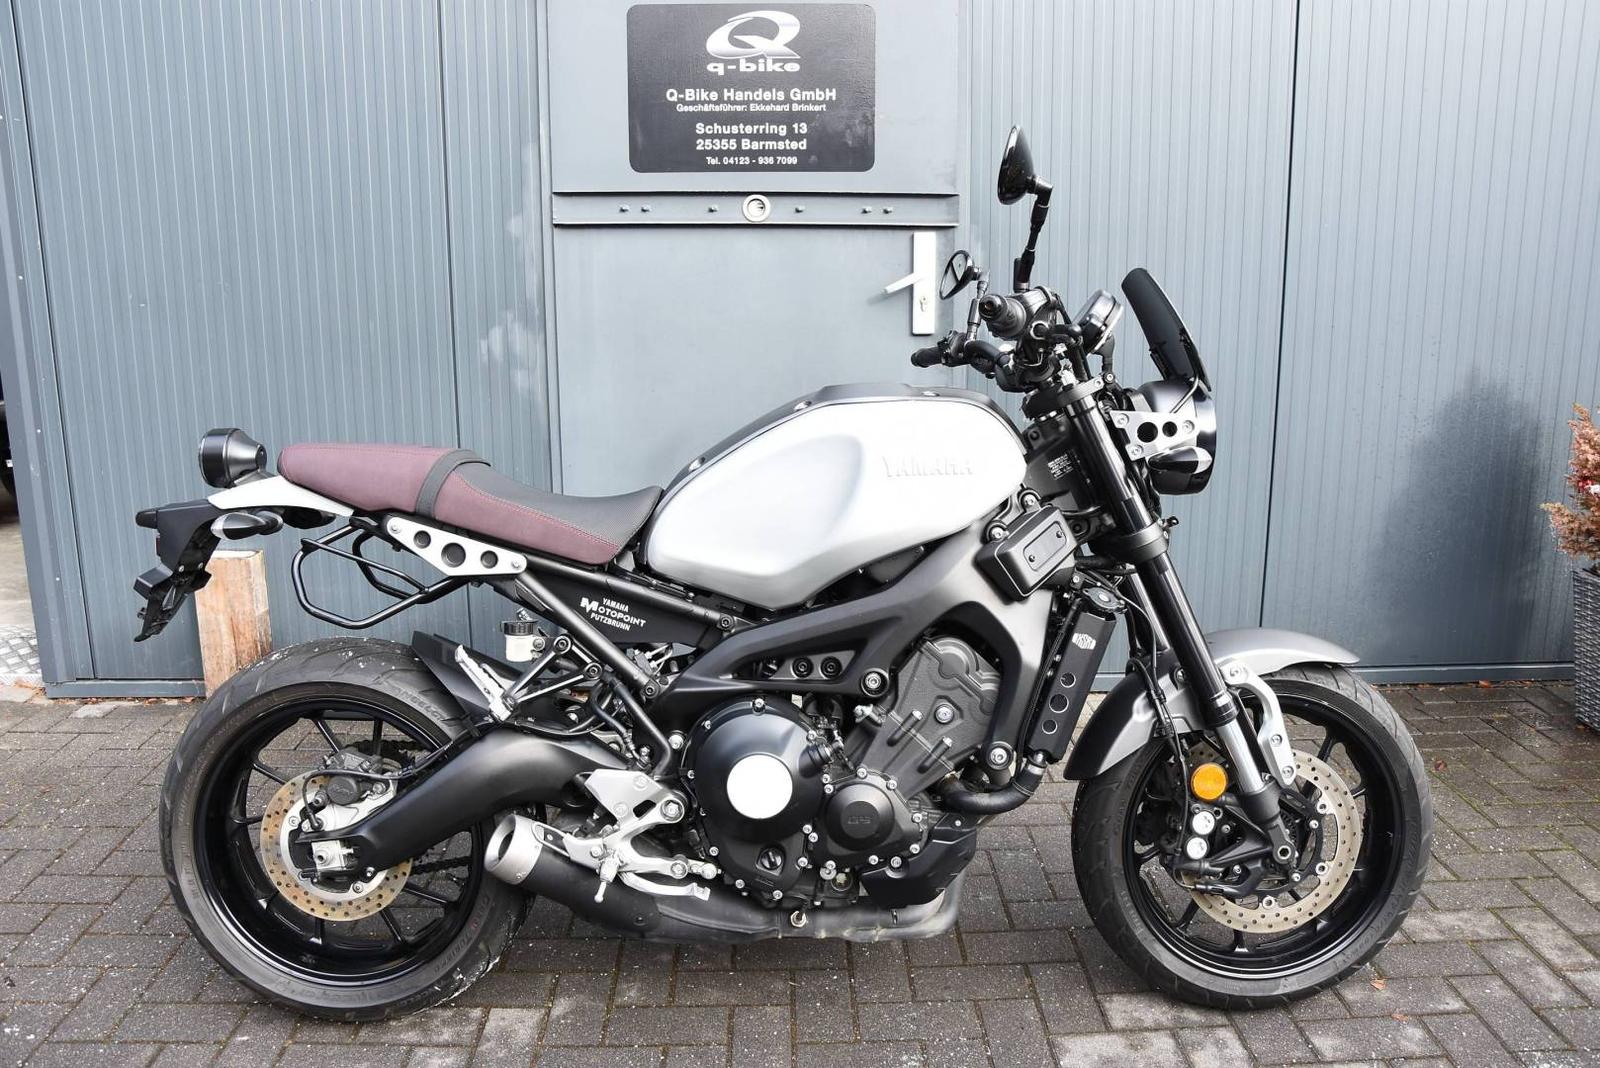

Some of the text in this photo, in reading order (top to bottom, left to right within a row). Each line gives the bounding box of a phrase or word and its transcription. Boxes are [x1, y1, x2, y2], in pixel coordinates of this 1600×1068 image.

[706, 60, 800, 75] q-bike
[666, 88, 836, 101] Q-Bike Handels GmbH
[676, 103, 826, 112] Geschäftsführer: Ekkehard Brinkert
[696, 123, 807, 136] Schusterring 13
[696, 139, 806, 150] 25355 Barmsted
[758, 157, 774, 165] 936
[777, 156, 797, 164] 7099
[881, 455, 976, 478] YAMAHA
[602, 598, 629, 612] YAMAHA
[590, 612, 631, 631] PUTZBRUNN
